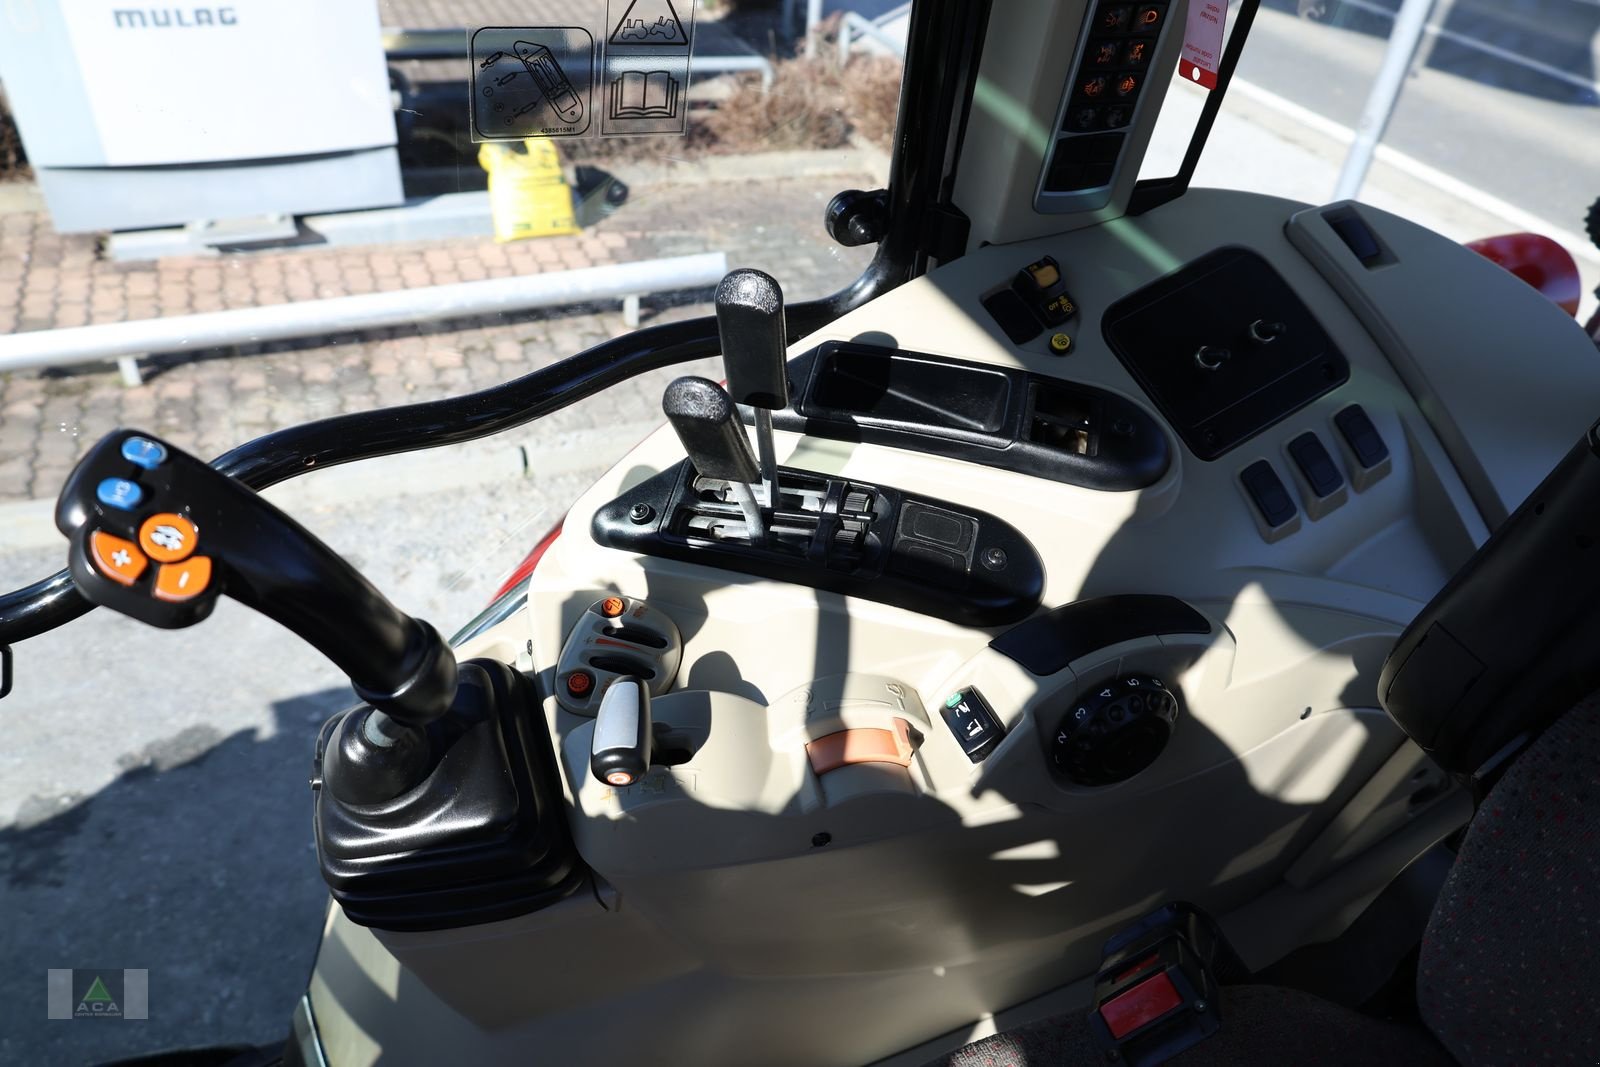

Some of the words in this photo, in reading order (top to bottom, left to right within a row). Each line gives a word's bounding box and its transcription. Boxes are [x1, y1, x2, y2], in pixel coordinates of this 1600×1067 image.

[113, 8, 238, 28] MULAG
[1057, 731, 1068, 744] 2
[1075, 707, 1086, 719] 3
[1099, 688, 1112, 697] 4
[1127, 678, 1140, 686] 5
